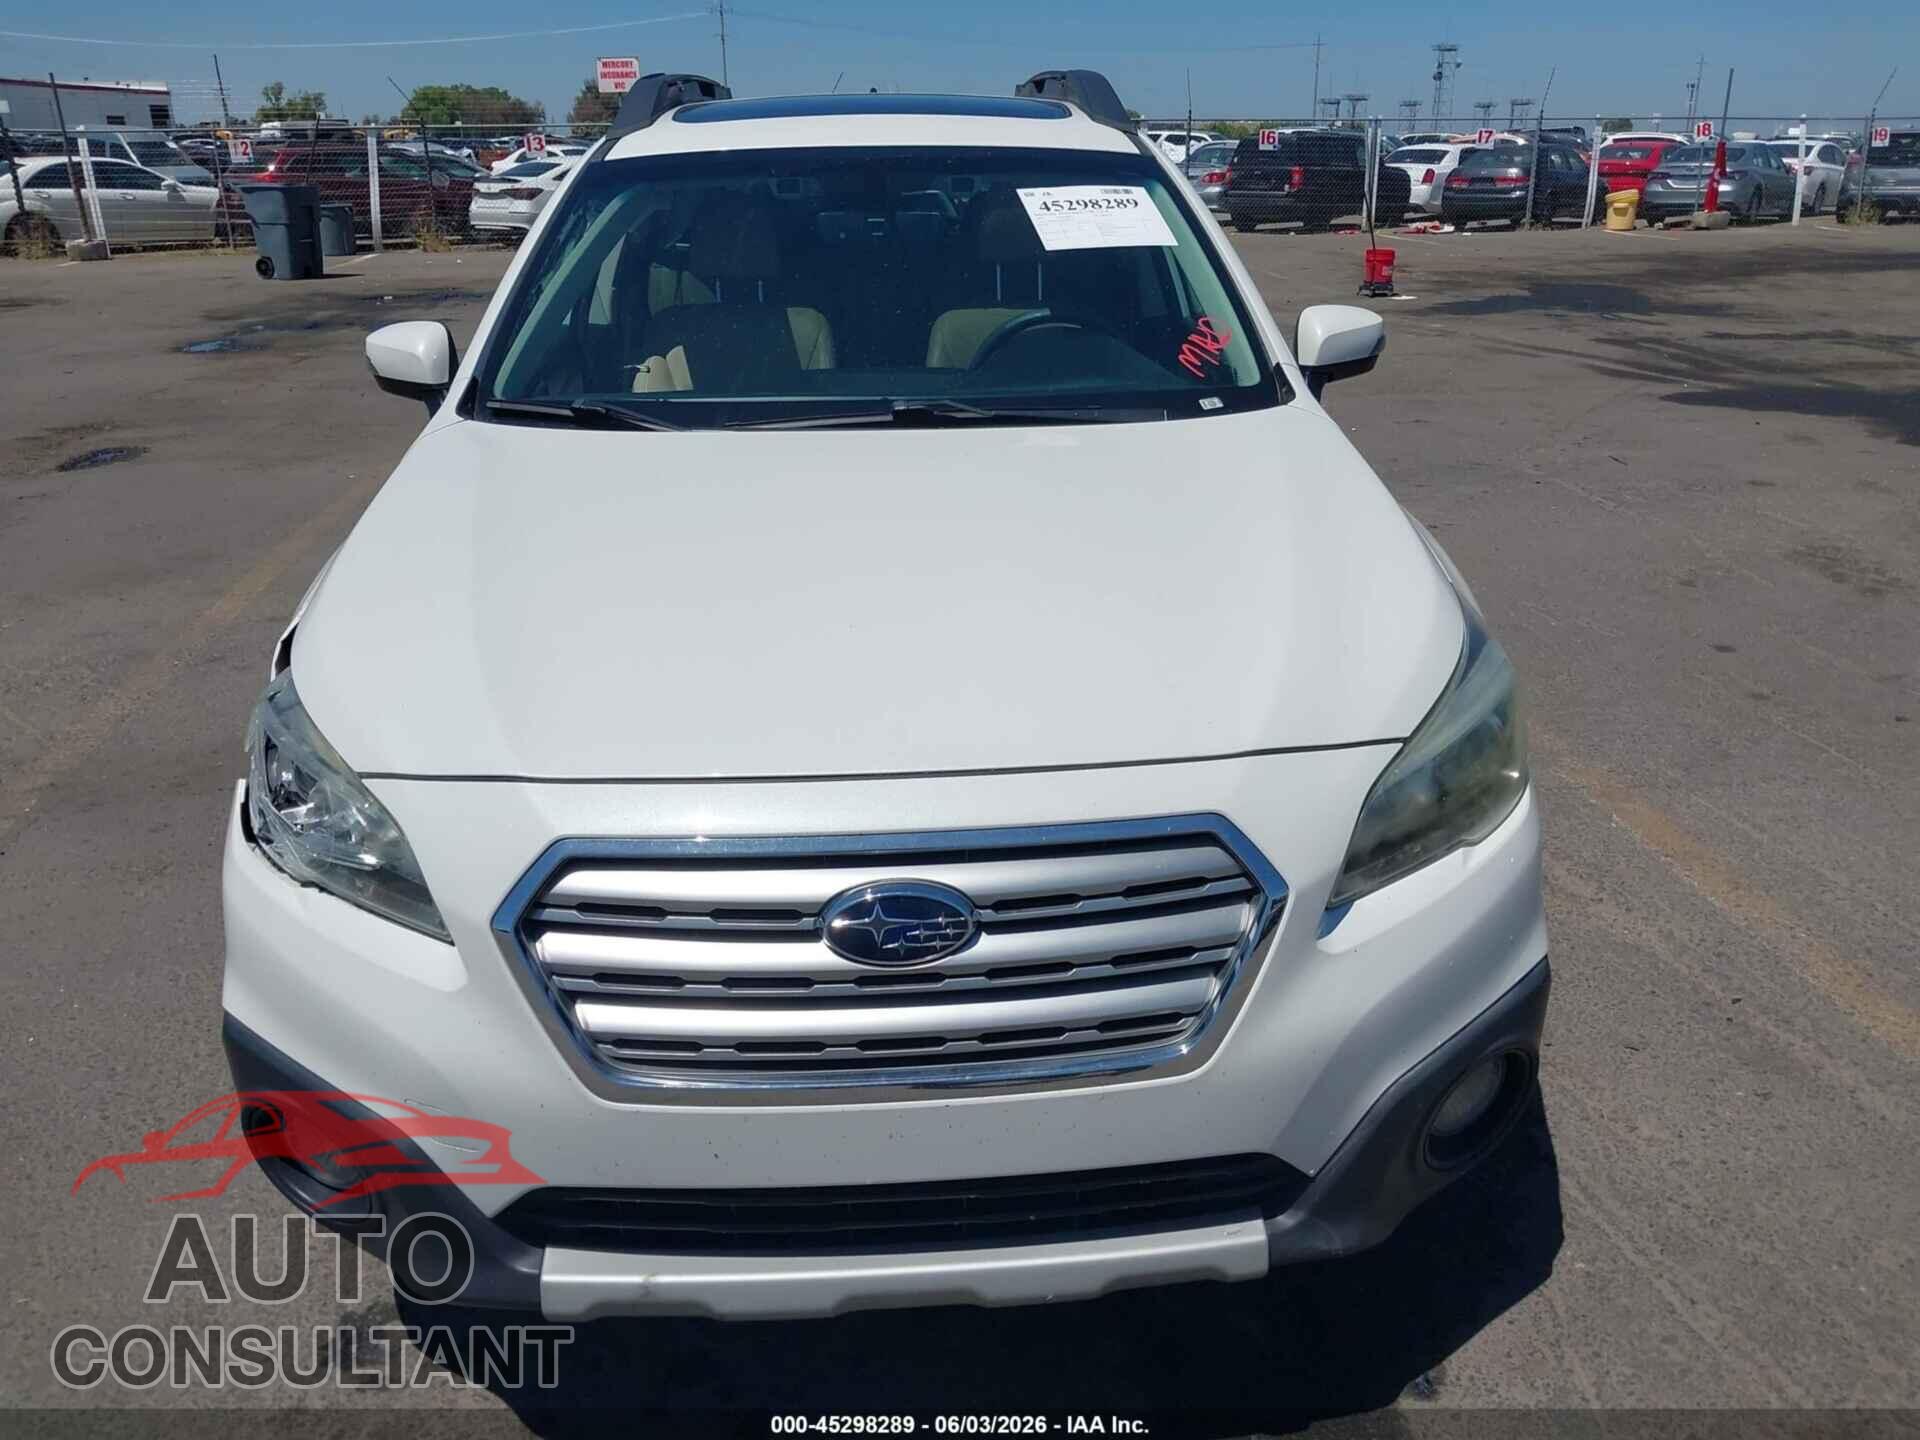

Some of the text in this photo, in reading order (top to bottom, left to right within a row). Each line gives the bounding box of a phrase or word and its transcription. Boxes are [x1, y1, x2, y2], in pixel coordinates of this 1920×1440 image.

[1478, 129, 1494, 144] 17
[1696, 122, 1712, 137] 18
[1873, 128, 1889, 142] 19
[527, 136, 545, 152] 13
[1260, 130, 1276, 145] 16
[1039, 197, 1139, 212] 45298289
